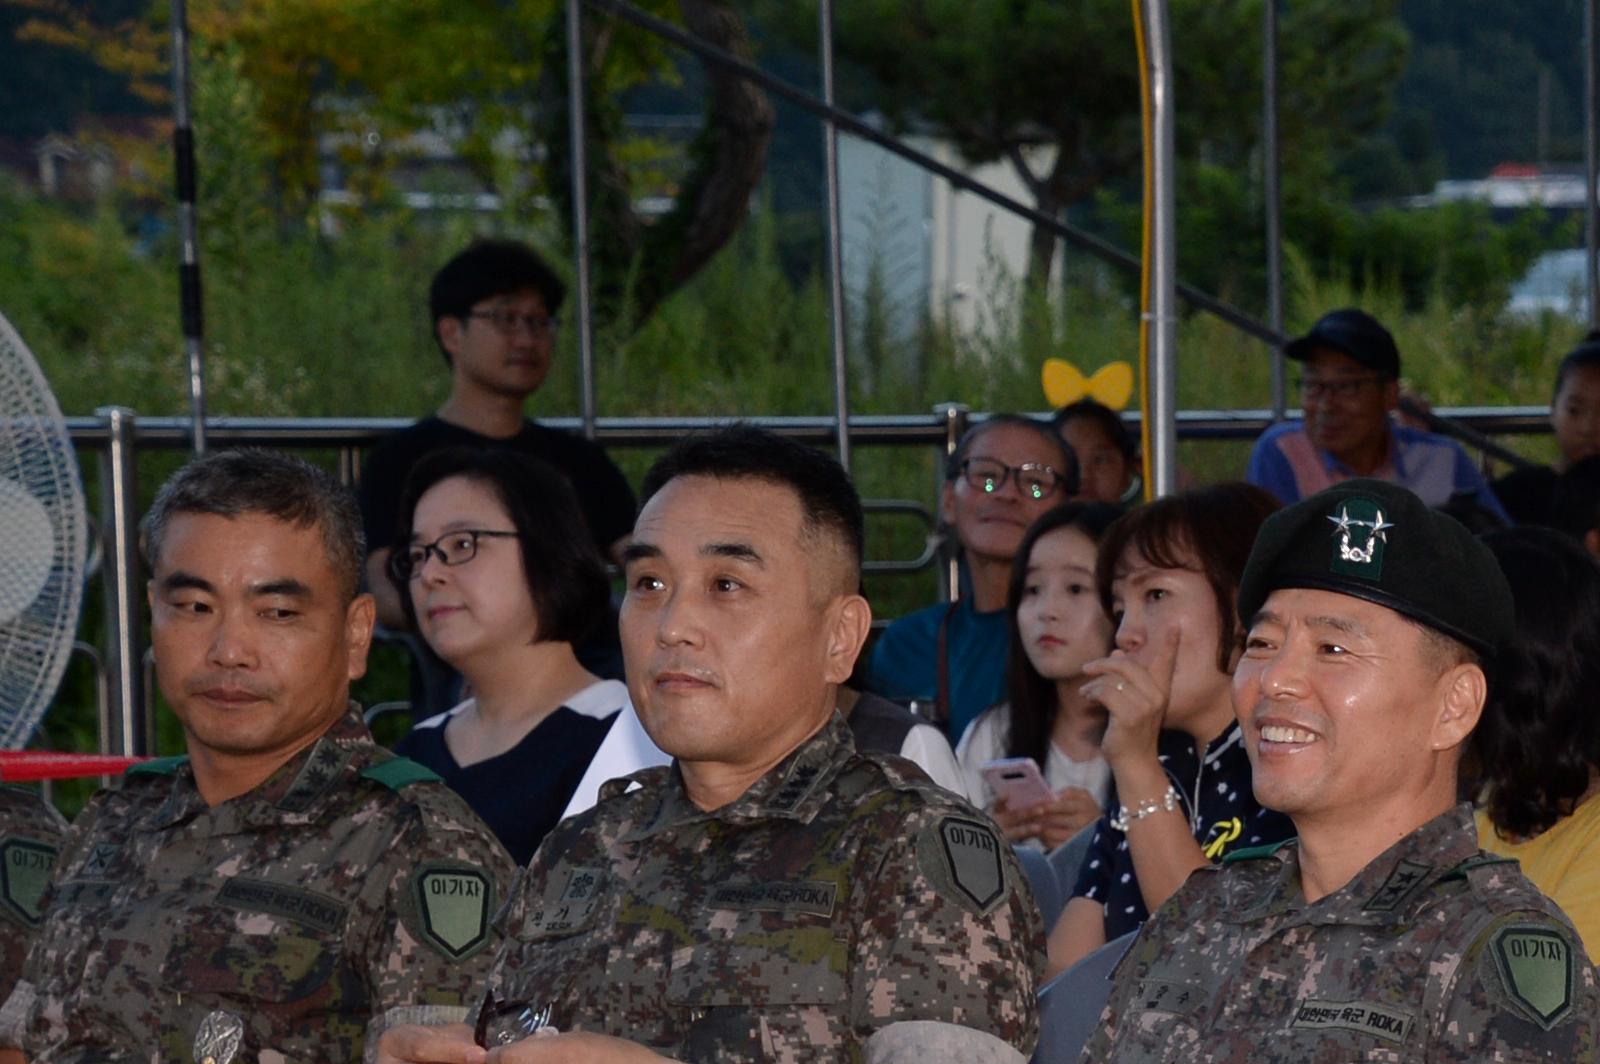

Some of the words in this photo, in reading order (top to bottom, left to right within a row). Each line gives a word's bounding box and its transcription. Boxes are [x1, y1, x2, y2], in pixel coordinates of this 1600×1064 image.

[950, 828, 993, 852] 이기자
[431, 878, 479, 896] 이기자
[1511, 939, 1561, 960] 이기자
[1366, 1011, 1404, 1036] ROKA
